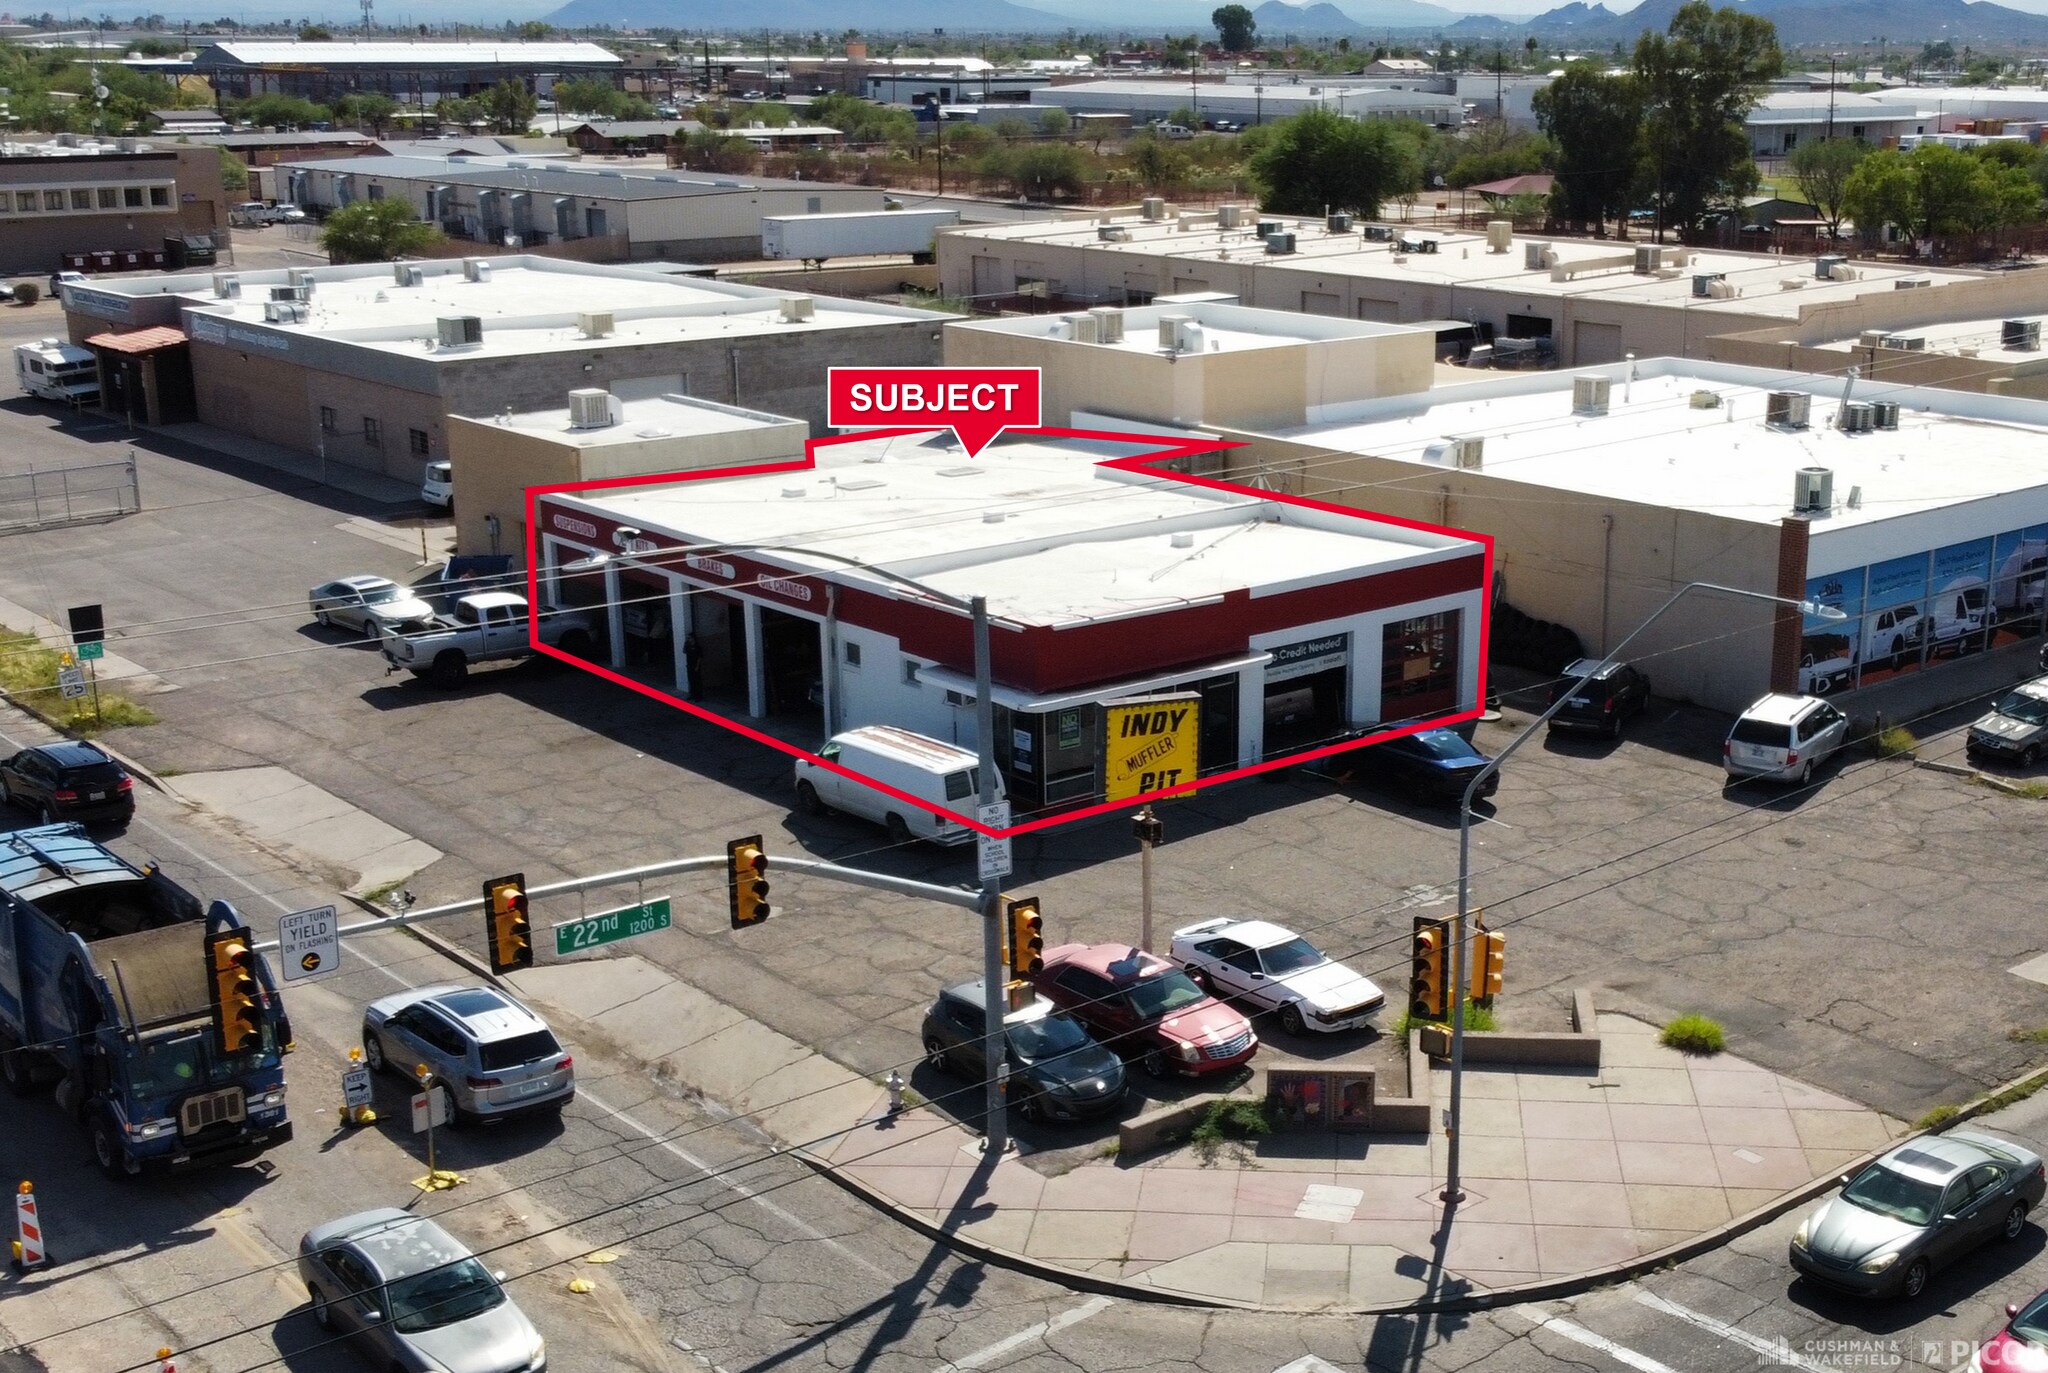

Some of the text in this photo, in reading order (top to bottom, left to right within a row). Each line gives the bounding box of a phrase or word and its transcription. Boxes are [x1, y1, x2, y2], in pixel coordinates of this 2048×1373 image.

[698, 558, 723, 576] BRAKES
[761, 575, 808, 600] OIL CHANGES
[61, 671, 79, 680] SPEED
[64, 683, 84, 697] 25
[1121, 708, 1189, 738] INDY
[1126, 736, 1175, 773] MUFFLER
[1138, 768, 1182, 796] PIT
[988, 806, 999, 815] NO
[283, 910, 332, 928] LEFT TURN
[560, 905, 654, 948] E 22nd St
[630, 914, 667, 934] 1200 S
[290, 922, 327, 941] YIELD
[285, 934, 334, 954] ON FLASHING
[346, 1072, 367, 1082] KEEP
[348, 1092, 370, 1104] RIGHT
